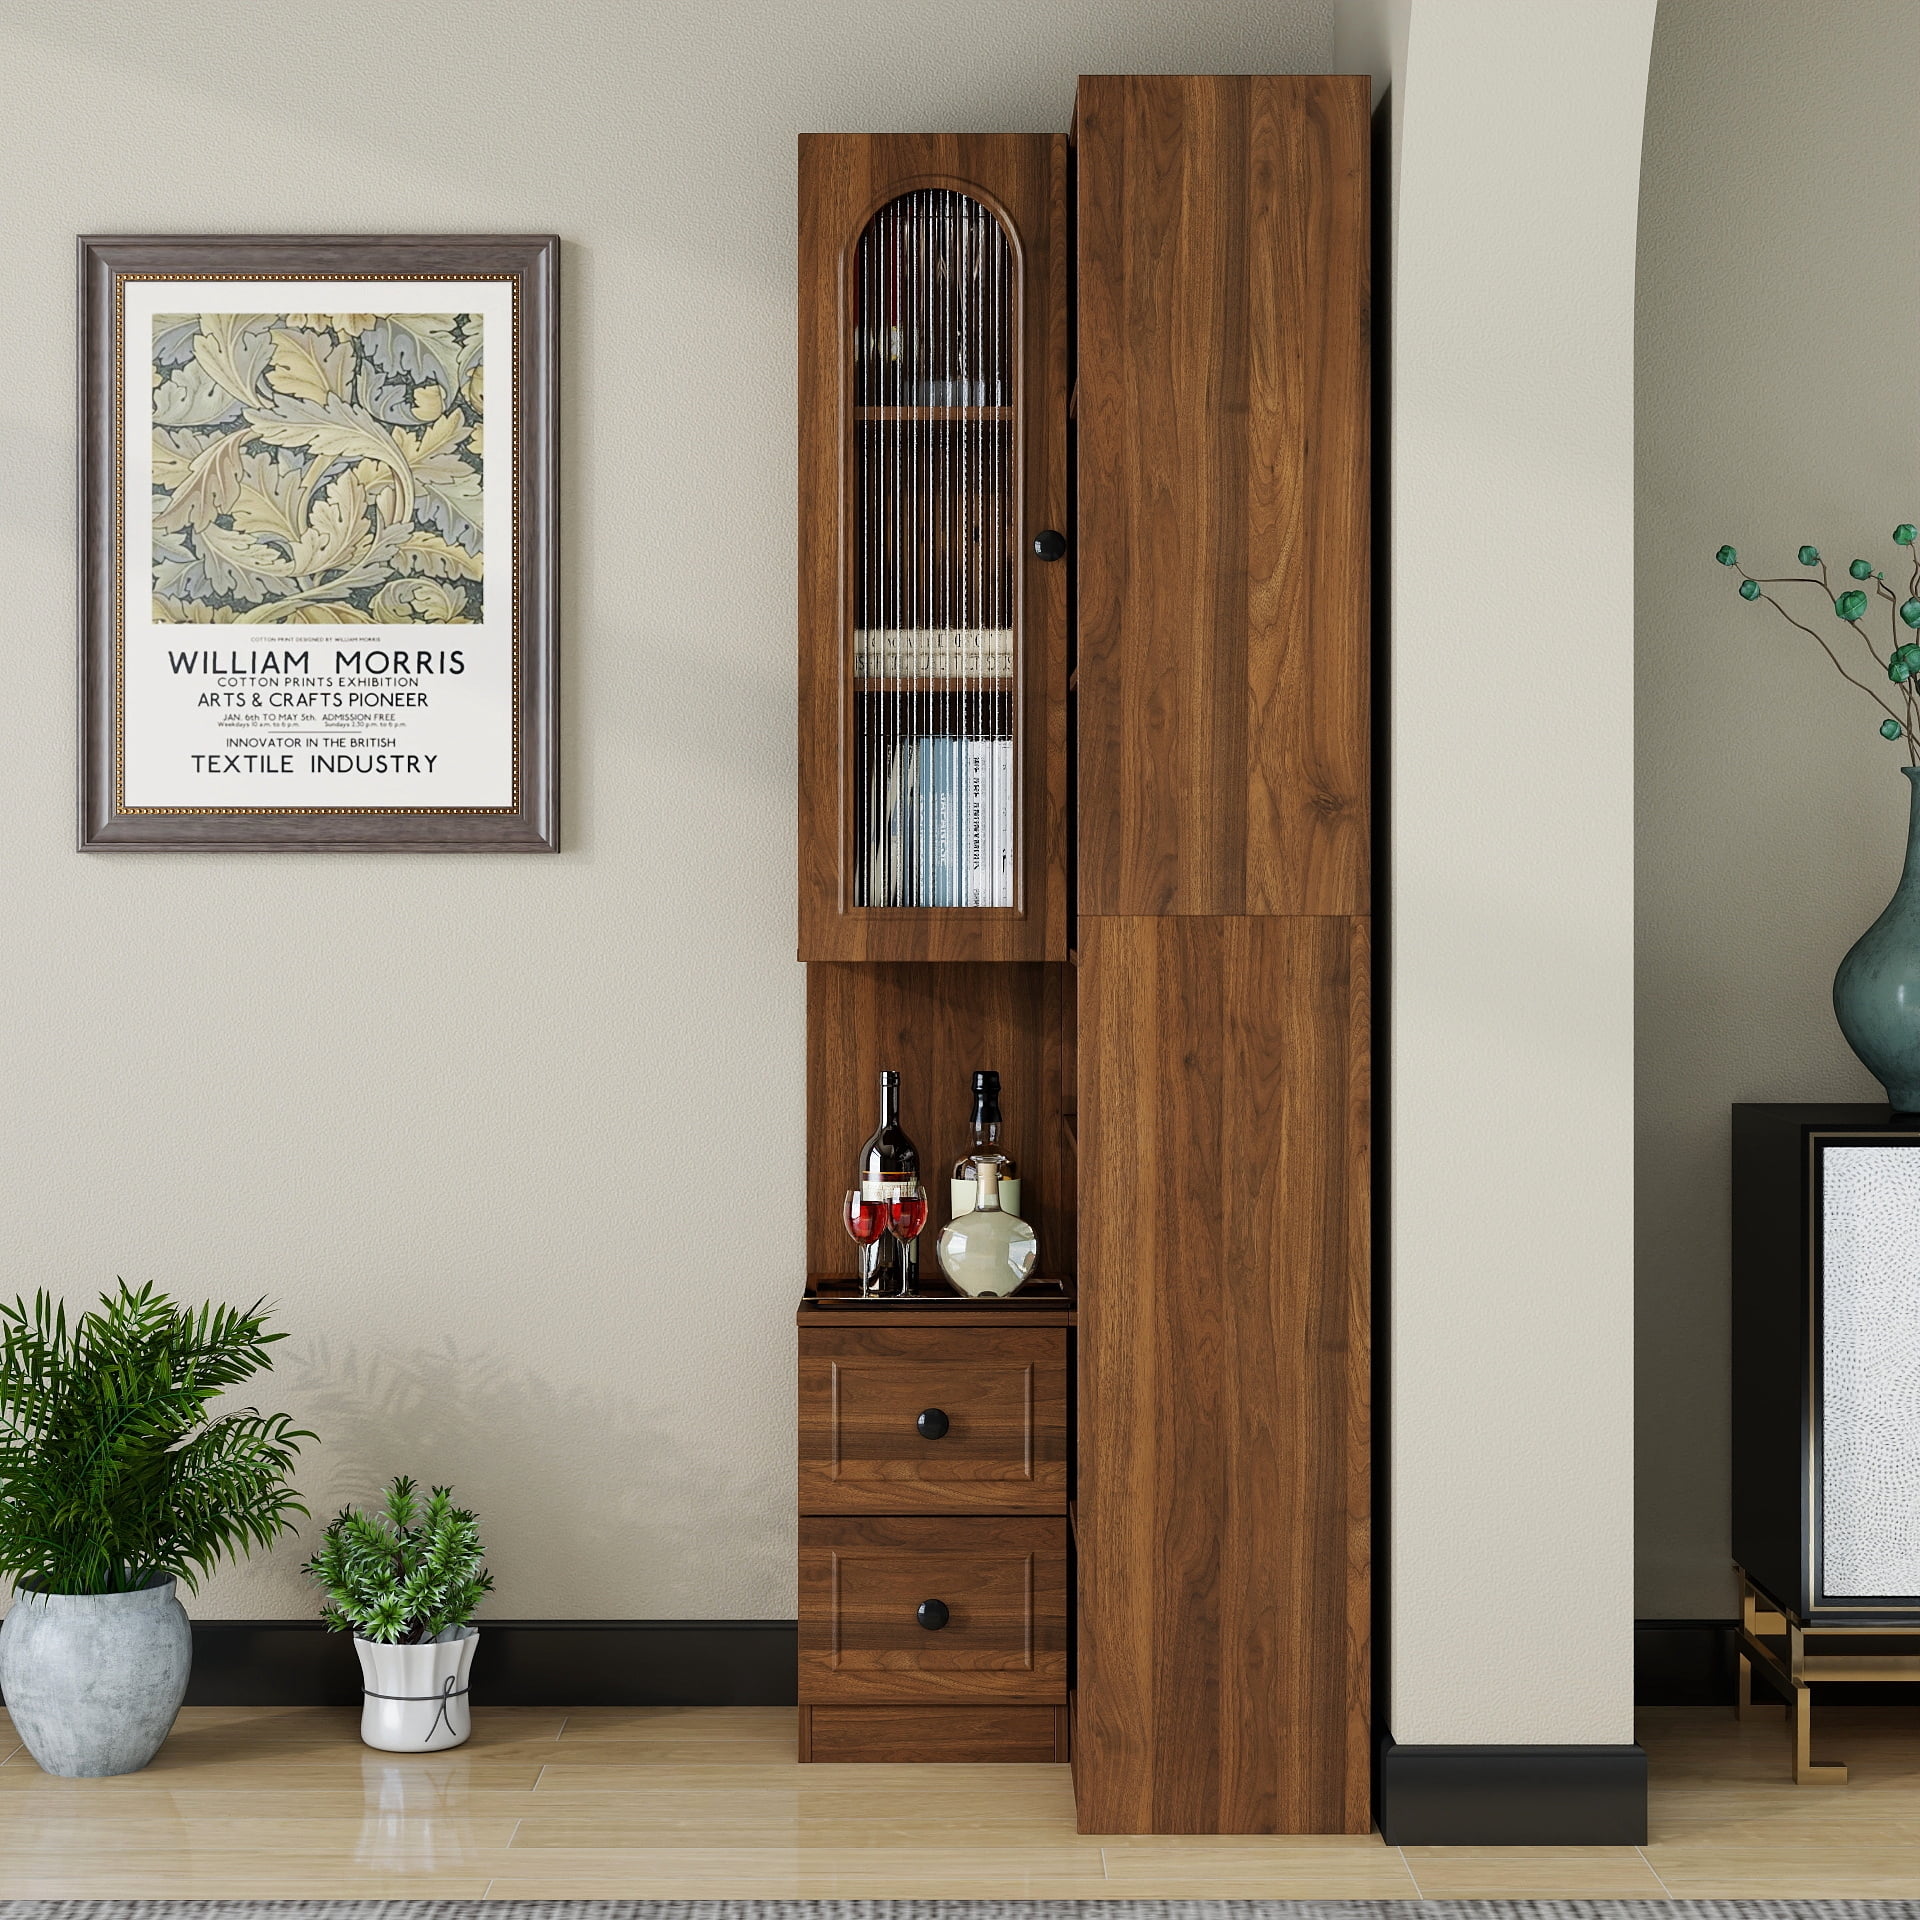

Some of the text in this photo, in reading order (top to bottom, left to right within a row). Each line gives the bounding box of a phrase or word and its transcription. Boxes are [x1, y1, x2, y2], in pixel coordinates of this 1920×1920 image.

[168, 650, 465, 675] WILLIAM MORRIS
[217, 677, 418, 687] COTTON PRINTS EXHIBITION
[198, 692, 428, 707] ARTS & CRAFTS PIONEER
[245, 713, 260, 721] 6th
[262, 713, 276, 721] TO
[278, 713, 298, 721] MAY
[322, 713, 371, 721] ADMISSION
[373, 713, 395, 721] FREE
[227, 738, 396, 748] INNOVATOR IN THE BRITISH
[191, 755, 437, 773] TEXTILE INDUSTRY
